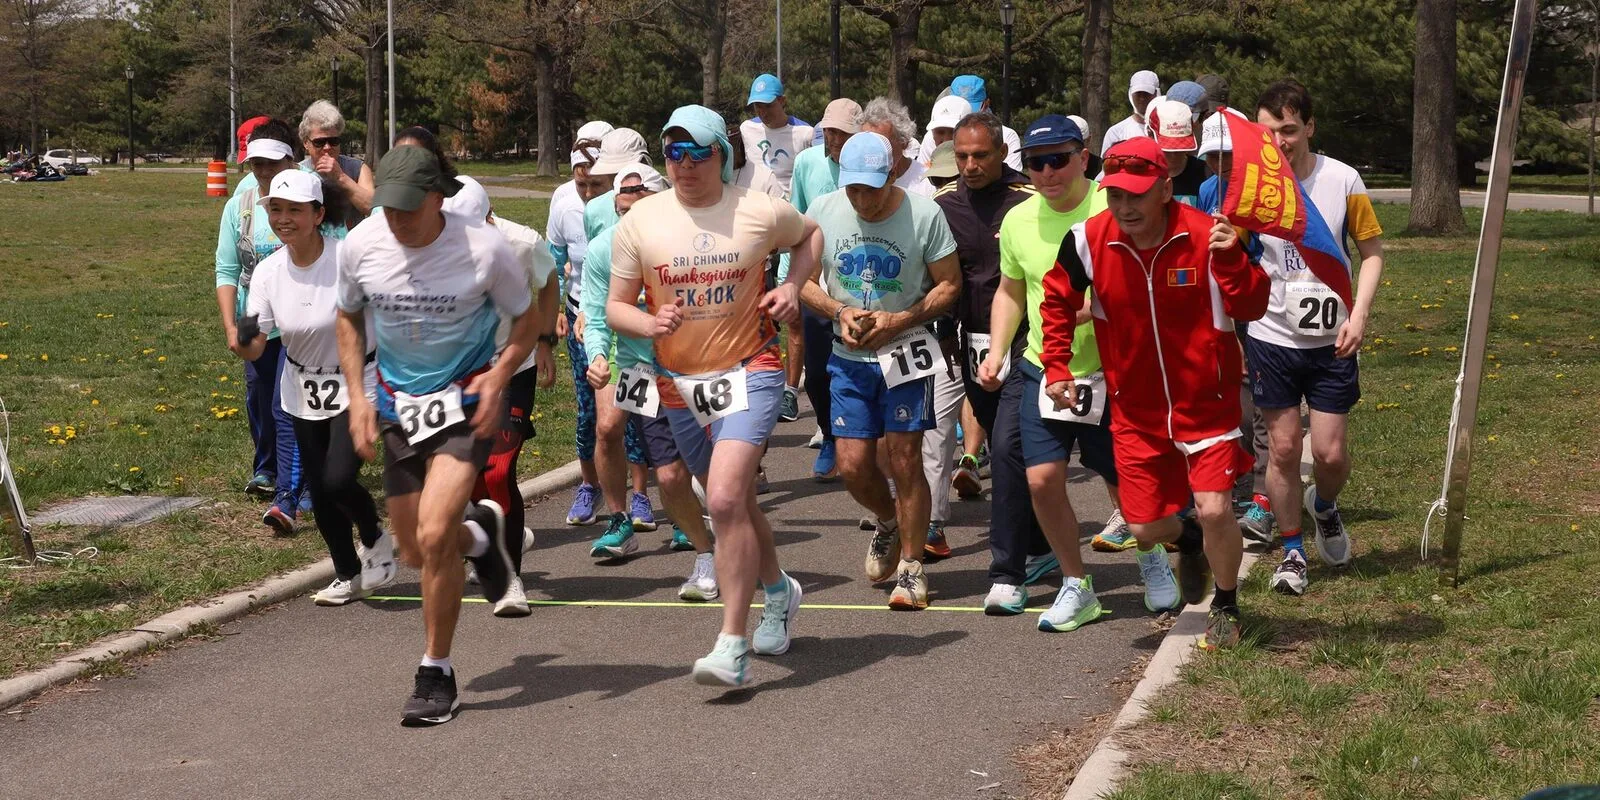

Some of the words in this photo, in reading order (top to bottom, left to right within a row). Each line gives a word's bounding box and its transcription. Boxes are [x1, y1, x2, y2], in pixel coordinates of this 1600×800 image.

[673, 256, 690, 268] SRI
[694, 251, 741, 266] CHINMOY
[833, 232, 907, 264] Self-Transcendence
[653, 263, 748, 287] Thanksgiving
[837, 252, 901, 279] 3100
[1285, 258, 1307, 272] RU
[394, 293, 458, 304] CHINMOY
[842, 281, 860, 290] Mile
[873, 282, 898, 291] Race
[1298, 296, 1339, 330] 20
[890, 338, 933, 377] 15
[303, 379, 341, 411] 32
[615, 371, 650, 408] 54
[693, 377, 733, 417] 48
[400, 399, 447, 438] 30
